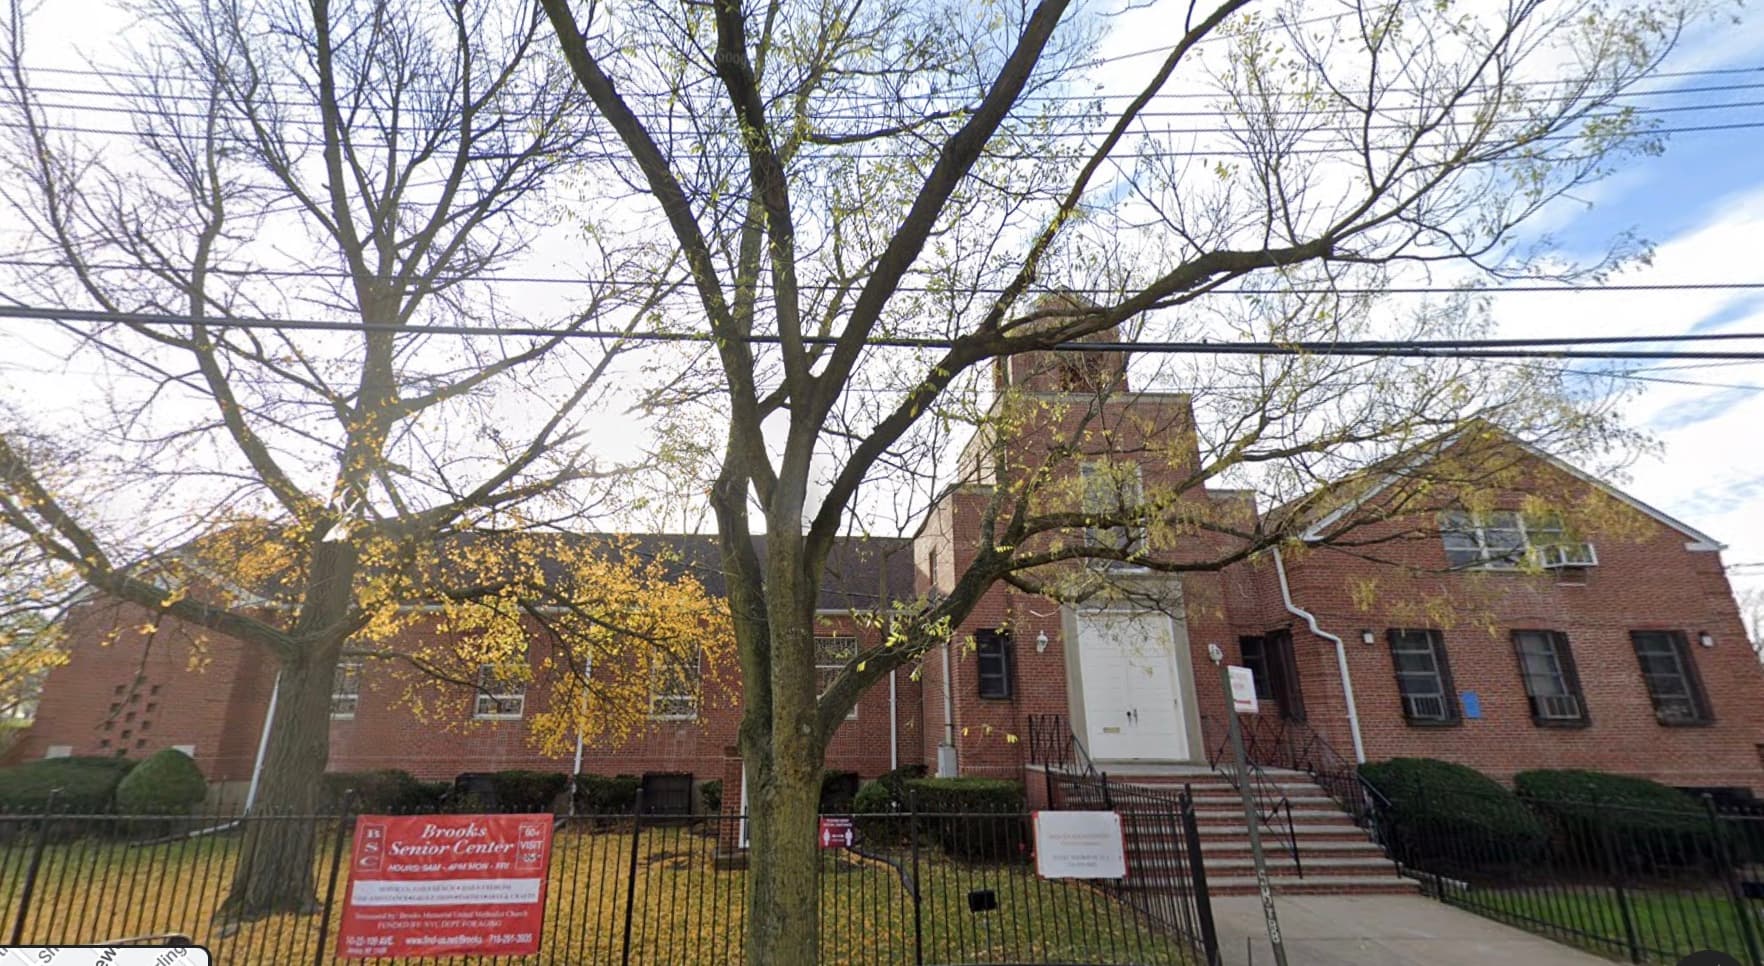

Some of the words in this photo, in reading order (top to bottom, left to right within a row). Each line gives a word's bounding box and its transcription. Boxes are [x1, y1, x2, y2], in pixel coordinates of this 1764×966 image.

[367, 829, 380, 838] B
[421, 822, 488, 839] Brooks
[364, 841, 378, 852] S
[388, 840, 450, 856] Senior
[452, 838, 515, 854] Center
[520, 840, 544, 850] VISIT
[360, 855, 379, 866] C
